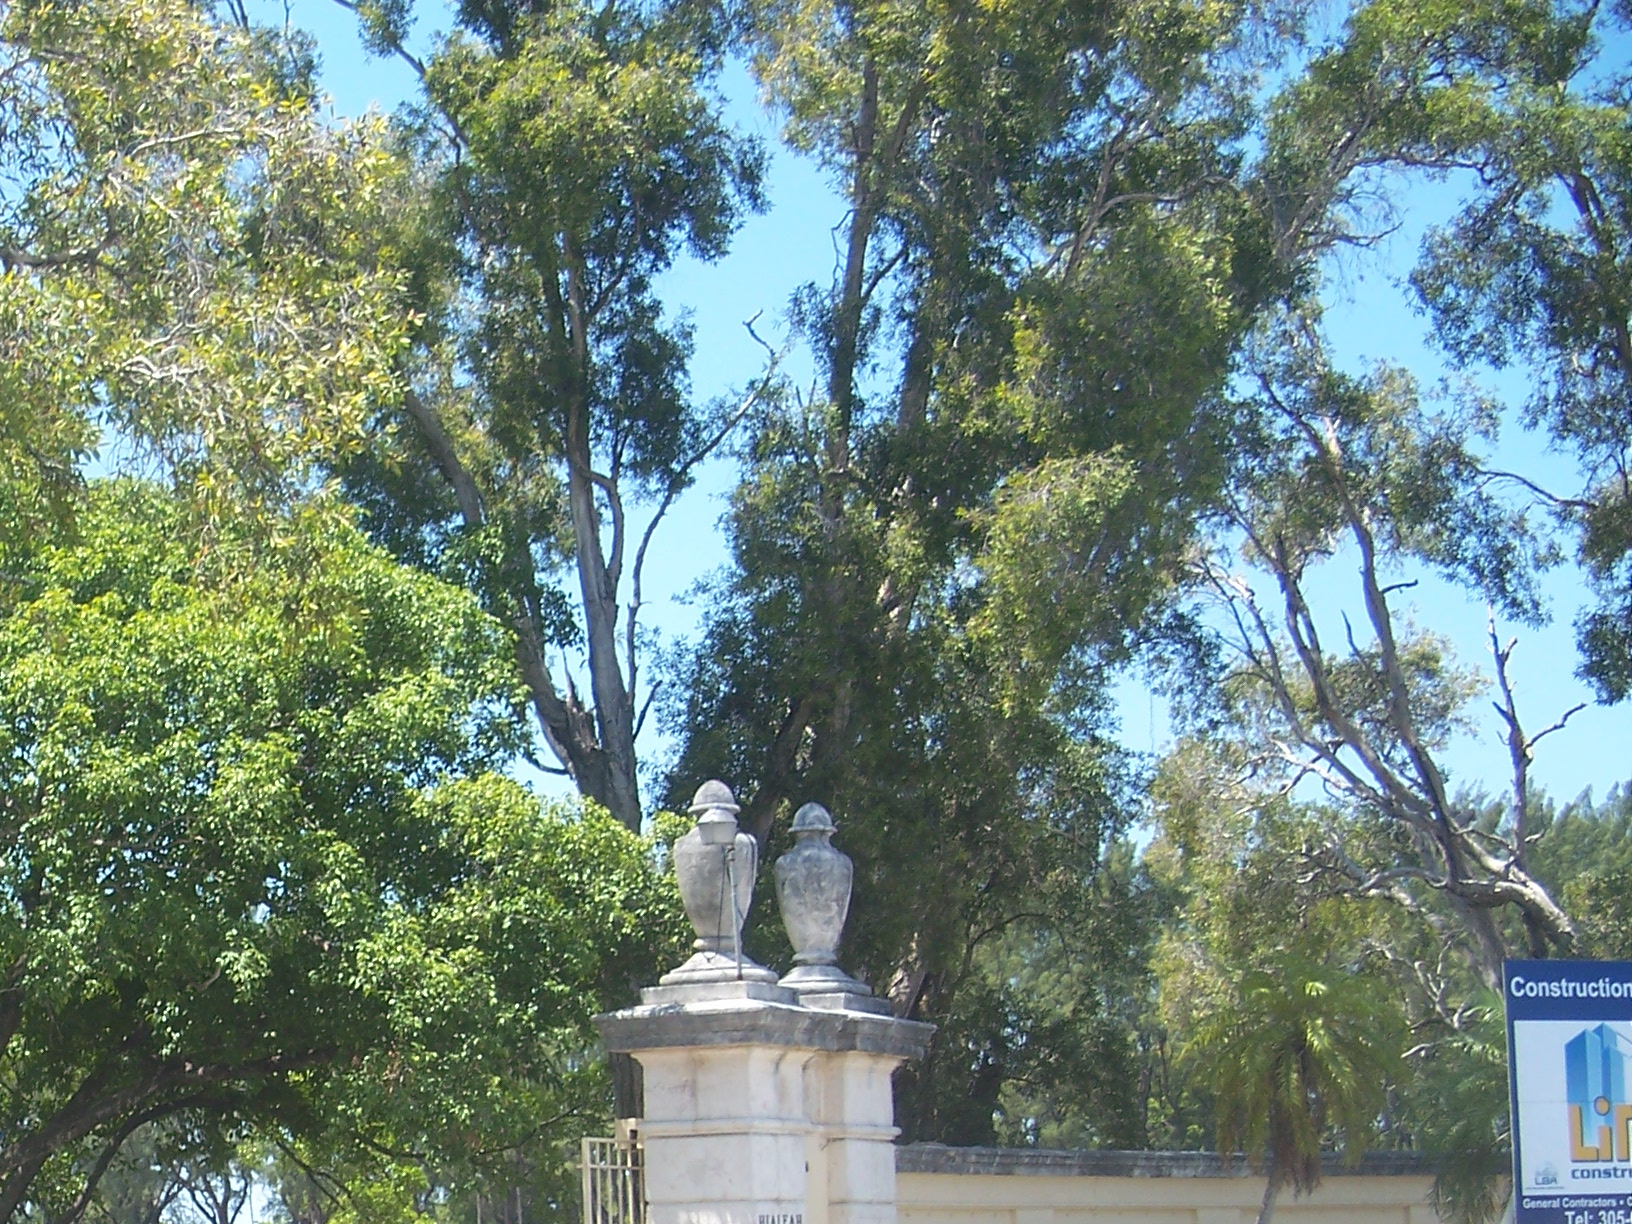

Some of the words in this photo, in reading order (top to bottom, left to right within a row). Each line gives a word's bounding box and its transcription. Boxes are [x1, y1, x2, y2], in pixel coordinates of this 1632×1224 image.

[1510, 976, 1632, 997] Construction
[1522, 1198, 1560, 1209] General
[1562, 1197, 1617, 1208] Contractors
